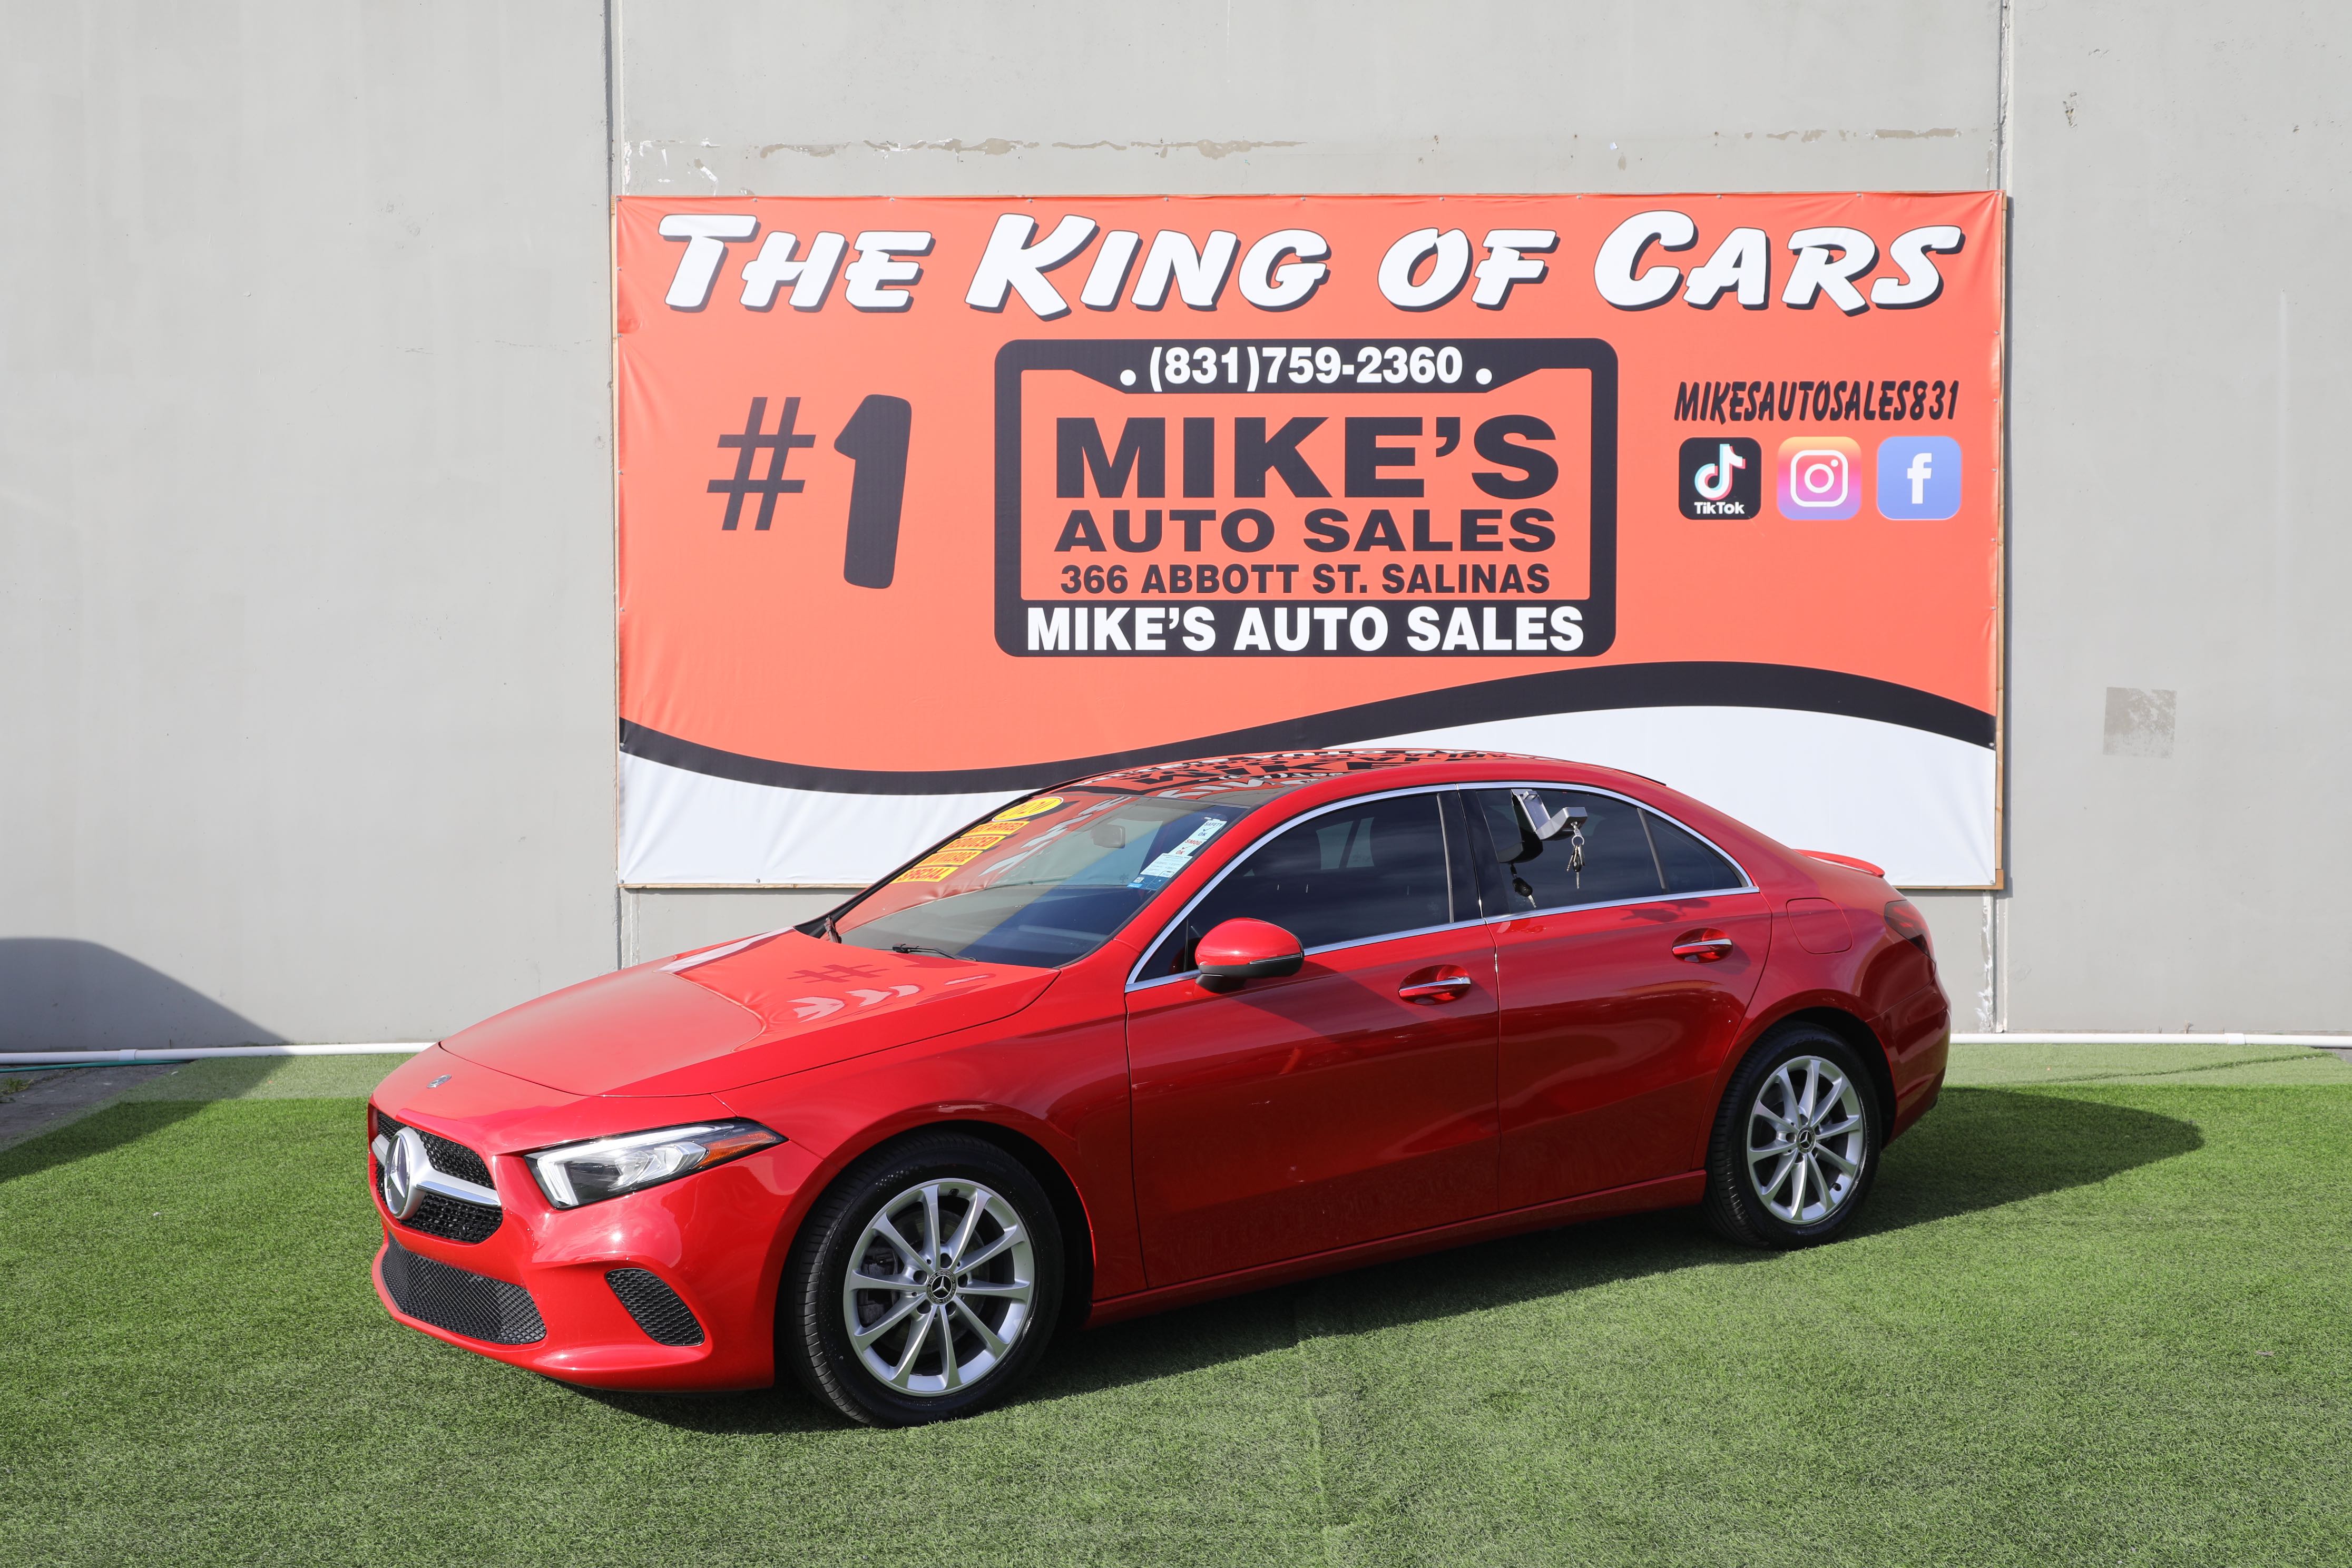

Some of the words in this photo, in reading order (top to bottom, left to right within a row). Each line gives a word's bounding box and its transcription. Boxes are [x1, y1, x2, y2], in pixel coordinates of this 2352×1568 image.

[658, 214, 936, 312] THE
[964, 213, 1331, 321] KING
[1377, 227, 1561, 312] OF
[1594, 210, 1966, 317] CARS
[1150, 346, 1463, 392] (831)759-2360
[1674, 380, 1959, 425] MIKESAUTOSALES831
[1056, 414, 1559, 500] MIKE'S
[707, 394, 912, 589] #1
[1694, 502, 1745, 515] TikTok
[1054, 508, 1275, 553] AUTO
[1303, 508, 1556, 553] SALES
[1061, 564, 1128, 594] 366
[1141, 563, 1299, 594] ABBOTT
[1312, 563, 1367, 594] ST.
[1381, 563, 1550, 594] SALINAS
[1027, 606, 1216, 651] MIKE'S
[1233, 606, 1388, 651] AUTO
[1407, 606, 1584, 651] SALES
[897, 868, 950, 881] SPECIAL
